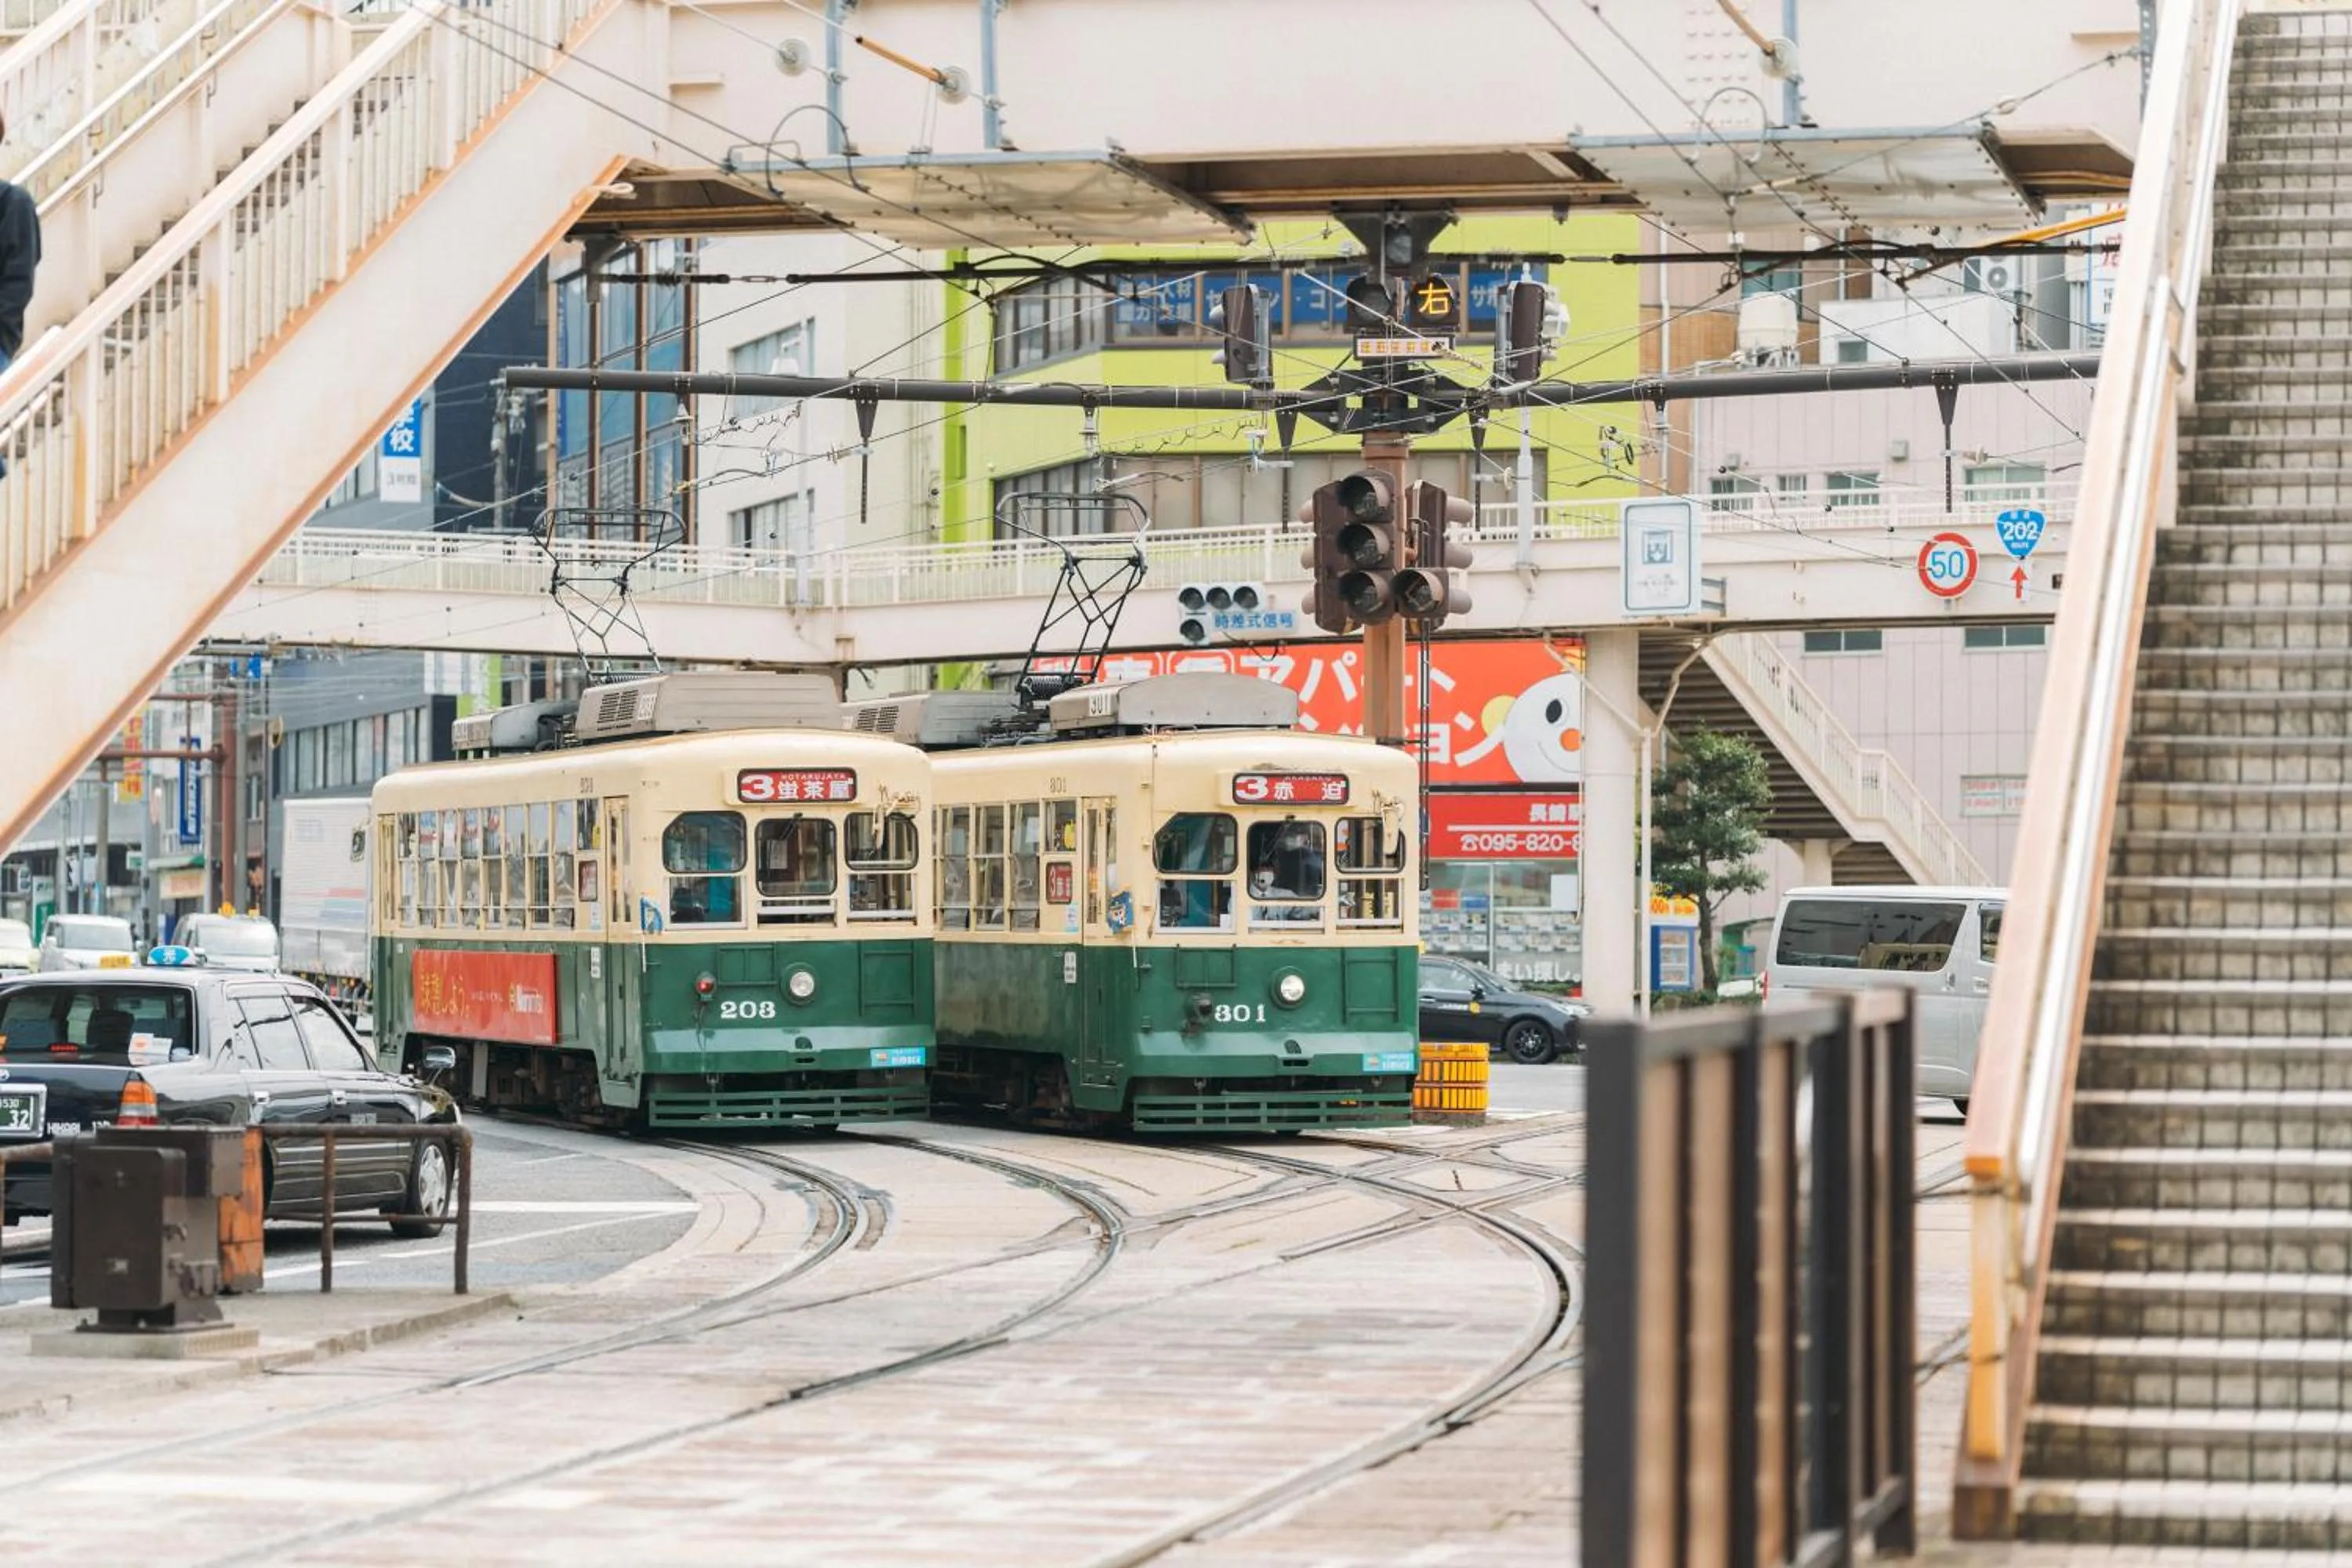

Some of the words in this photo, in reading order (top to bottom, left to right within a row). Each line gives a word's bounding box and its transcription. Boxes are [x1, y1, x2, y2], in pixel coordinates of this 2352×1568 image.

[1418, 283, 1450, 314] 右
[2003, 521, 2039, 539] 202
[1931, 550, 1964, 579] 50
[741, 774, 775, 800] 3
[1236, 776, 1269, 800] 3
[720, 1000, 775, 1018] 203
[9, 1109, 30, 1128] 32
